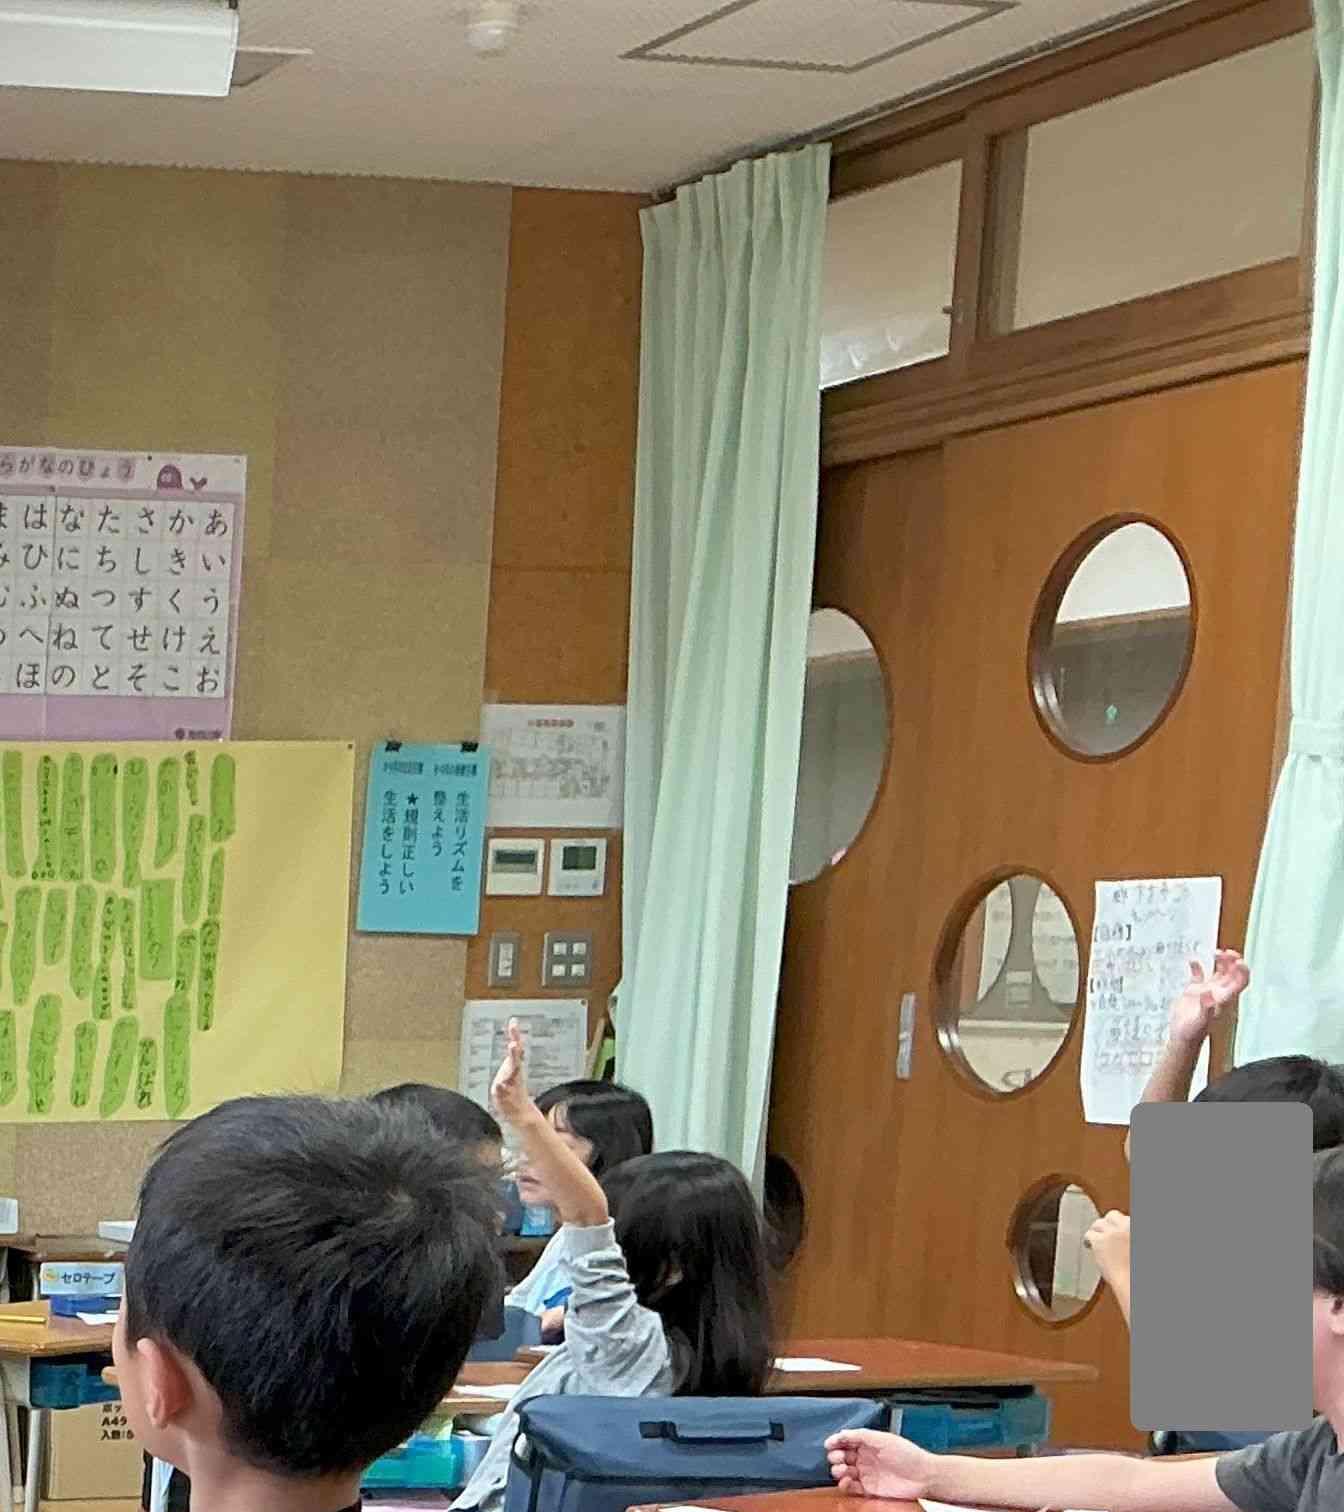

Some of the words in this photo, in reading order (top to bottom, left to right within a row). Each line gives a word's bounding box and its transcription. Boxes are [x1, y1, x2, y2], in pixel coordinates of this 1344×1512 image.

[23, 503, 48, 530] は
[59, 503, 85, 533] な
[97, 504, 121, 534] た
[137, 506, 155, 535] さ
[168, 508, 195, 536] か
[204, 508, 229, 537] あ
[21, 543, 49, 571] ひ
[56, 546, 80, 572] に
[97, 545, 117, 574] ち
[135, 546, 151, 576] し
[169, 547, 186, 576] き
[201, 553, 226, 572] い
[19, 584, 47, 610] ふ
[54, 586, 80, 609] ぬ
[91, 589, 117, 607] つ
[127, 586, 153, 613] す
[168, 587, 181, 614] く
[202, 587, 219, 615] う
[18, 627, 44, 644] へ
[50, 622, 79, 651] ね
[91, 623, 114, 651] て
[126, 624, 153, 652] せ
[162, 624, 187, 653] け
[199, 626, 221, 656] え
[15, 662, 41, 689] ほ
[50, 664, 76, 688] の
[91, 663, 110, 691] と
[127, 663, 147, 693] そ
[163, 665, 180, 692] こ
[196, 665, 220, 694] お
[379, 789, 397, 896] 生活をしよう
[451, 790, 470, 892] 生活リズムを
[61, 1272, 116, 1285] セロテープ
